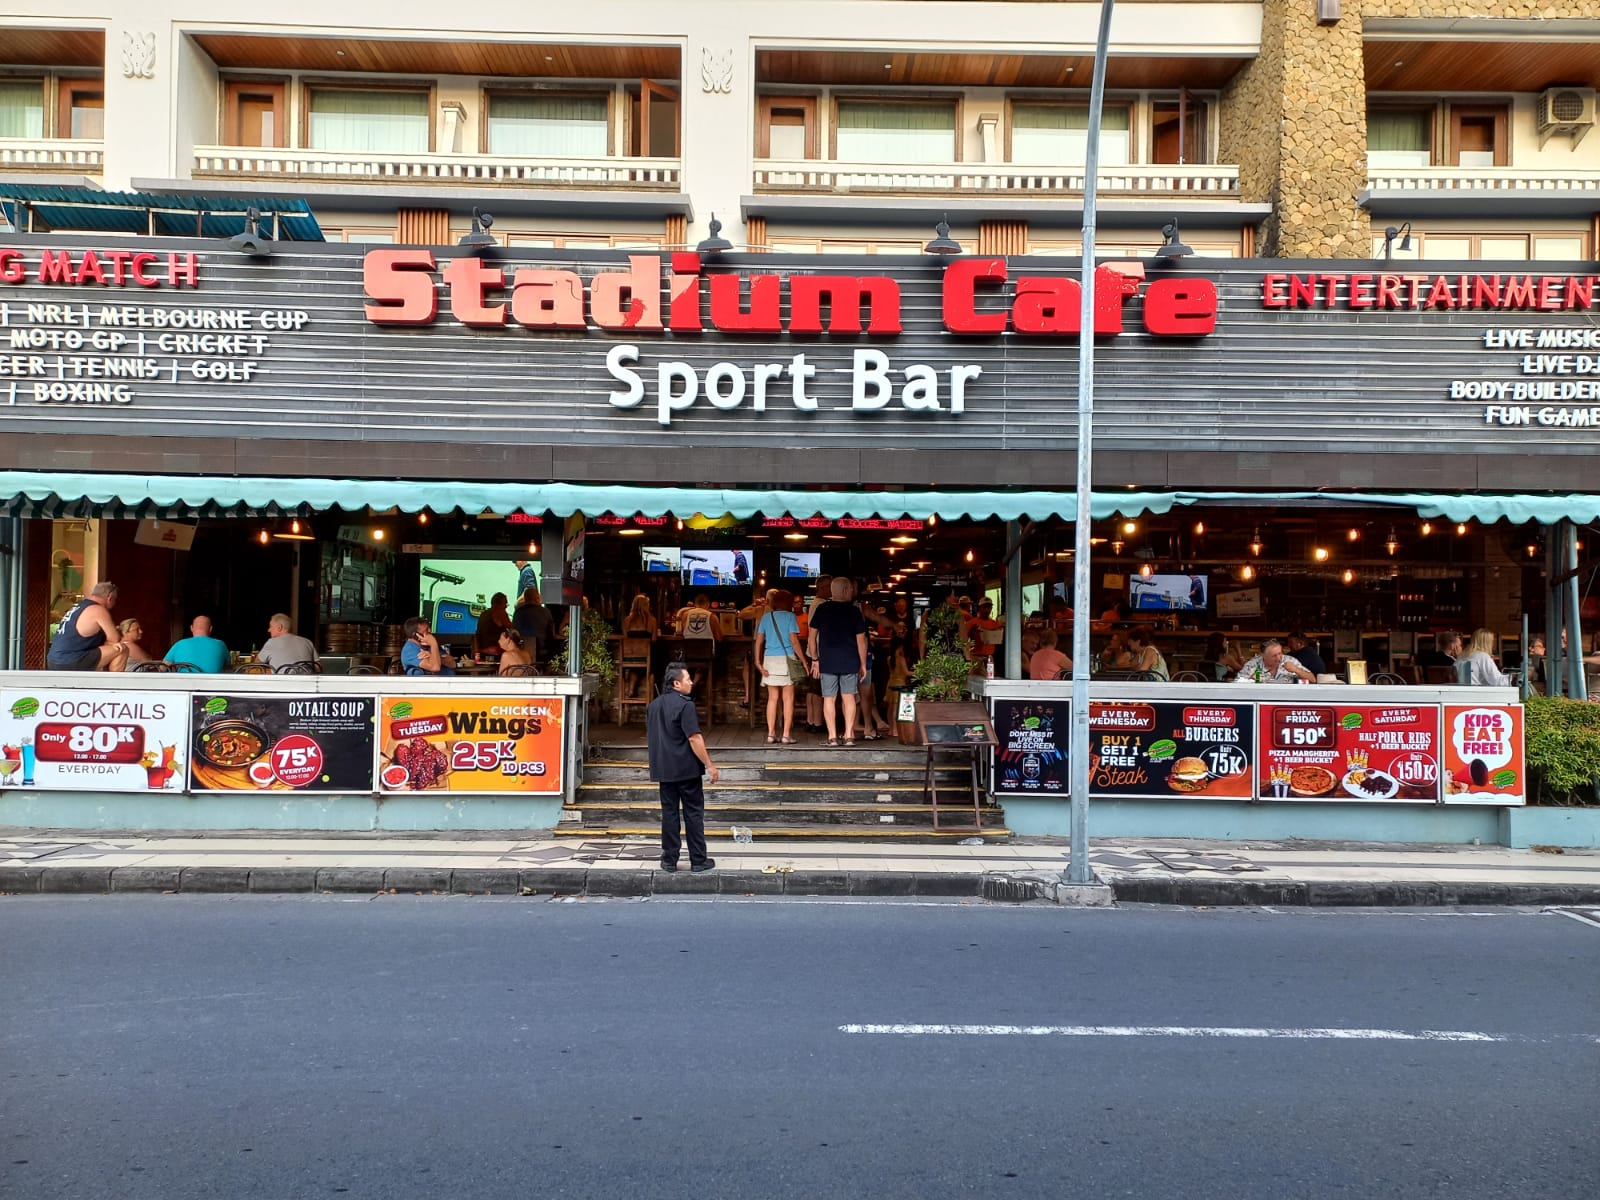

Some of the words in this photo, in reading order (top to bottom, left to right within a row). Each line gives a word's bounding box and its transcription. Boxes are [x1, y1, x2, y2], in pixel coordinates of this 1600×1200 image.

[39, 249, 199, 288] MATCH
[364, 249, 902, 334] Stadium
[942, 259, 1217, 336] Cafe
[1263, 274, 1600, 309] ENTERTAINMEN
[28, 303, 78, 325] NRL
[100, 306, 251, 330] MELBOURNE
[260, 311, 309, 331] CUP
[10, 328, 83, 350] MOTO
[92, 331, 126, 351] GP
[158, 333, 270, 355] CRICKET
[1485, 329, 1534, 348] LIVE
[71, 357, 159, 379] TENNIS
[192, 361, 258, 382] GOLF
[1523, 355, 1573, 373] LIVE
[34, 382, 132, 403] BOXING
[606, 345, 818, 425] Sport
[851, 348, 982, 414] Bar
[1485, 406, 1530, 424] FUN
[45, 701, 166, 720] COCKTAILS
[288, 701, 330, 717] OXTAIL
[332, 702, 364, 717] SOUP
[490, 706, 547, 716] CHICKEN
[449, 711, 541, 739] Wings
[1089, 718, 1149, 726] WEDNESDAY
[1285, 715, 1322, 723] FRIDAY
[1375, 715, 1417, 724] SATURDAY
[1464, 714, 1502, 727] KIDS
[41, 733, 66, 742] Only
[399, 723, 443, 736] TUESDAY
[1173, 729, 1185, 738] ALL
[1185, 727, 1240, 742] BURGERS
[1281, 727, 1327, 745] 150K
[1359, 732, 1377, 741] HALF
[1378, 731, 1404, 743] PORK
[1409, 732, 1431, 744] RIBS
[1463, 727, 1504, 741] EAT
[1008, 741, 1022, 749] BIG
[1102, 736, 1130, 745] BUY
[1135, 736, 1142, 746] 1
[1463, 742, 1503, 755] FREE!
[276, 746, 318, 768] 75K
[453, 741, 514, 770] 25K
[1101, 746, 1128, 755] GET
[1132, 747, 1139, 756] 1
[1292, 750, 1340, 758] MARGHERITA
[58, 764, 121, 774] EVERYDAY
[502, 762, 516, 773] 10
[520, 763, 545, 775] PCS
[1101, 756, 1136, 766] FREE
[1209, 752, 1242, 774] 75K
[279, 766, 315, 775] EVERYDAY
[1097, 766, 1148, 787] Steak
[1397, 760, 1435, 780] 150K
